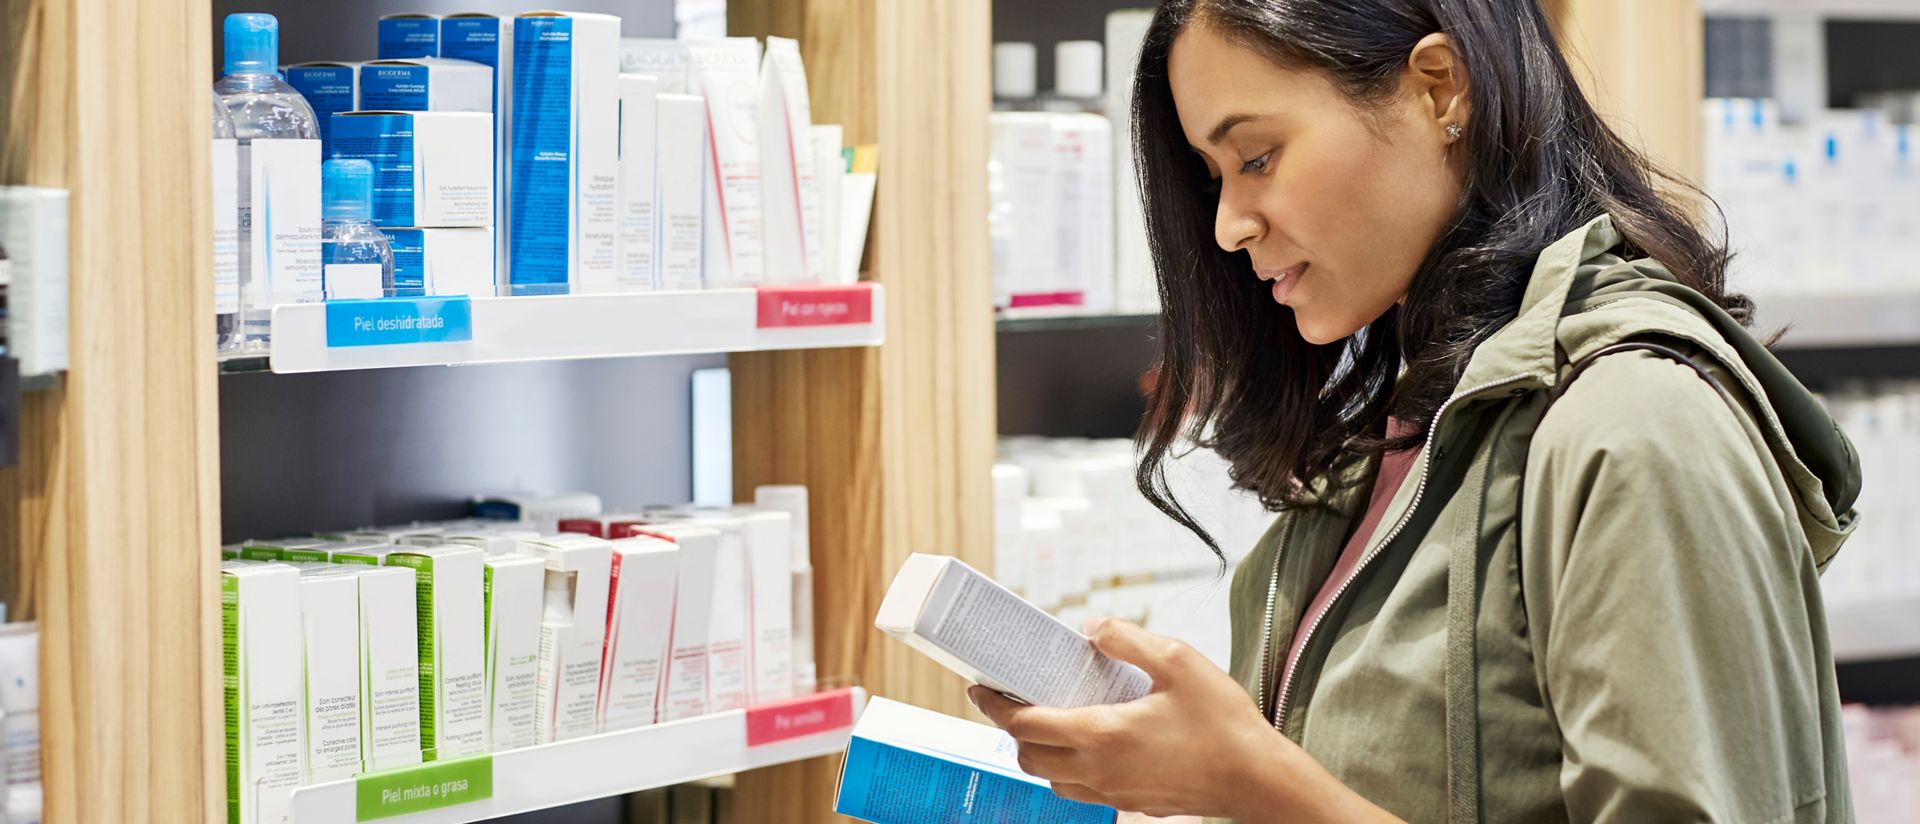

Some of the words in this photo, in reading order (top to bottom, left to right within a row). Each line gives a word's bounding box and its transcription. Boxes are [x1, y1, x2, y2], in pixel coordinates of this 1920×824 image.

[354, 316, 374, 332] Piel
[377, 314, 444, 331] deshidratada
[251, 551, 277, 559] BIODERMA
[292, 554, 318, 562] BIODERMA
[331, 695, 356, 704] correcteur
[326, 704, 340, 713] pores
[322, 738, 346, 747] Corrective
[382, 787, 401, 804] Piel
[404, 784, 431, 801] mixta
[433, 786, 439, 795] o
[441, 779, 468, 797] grasa
